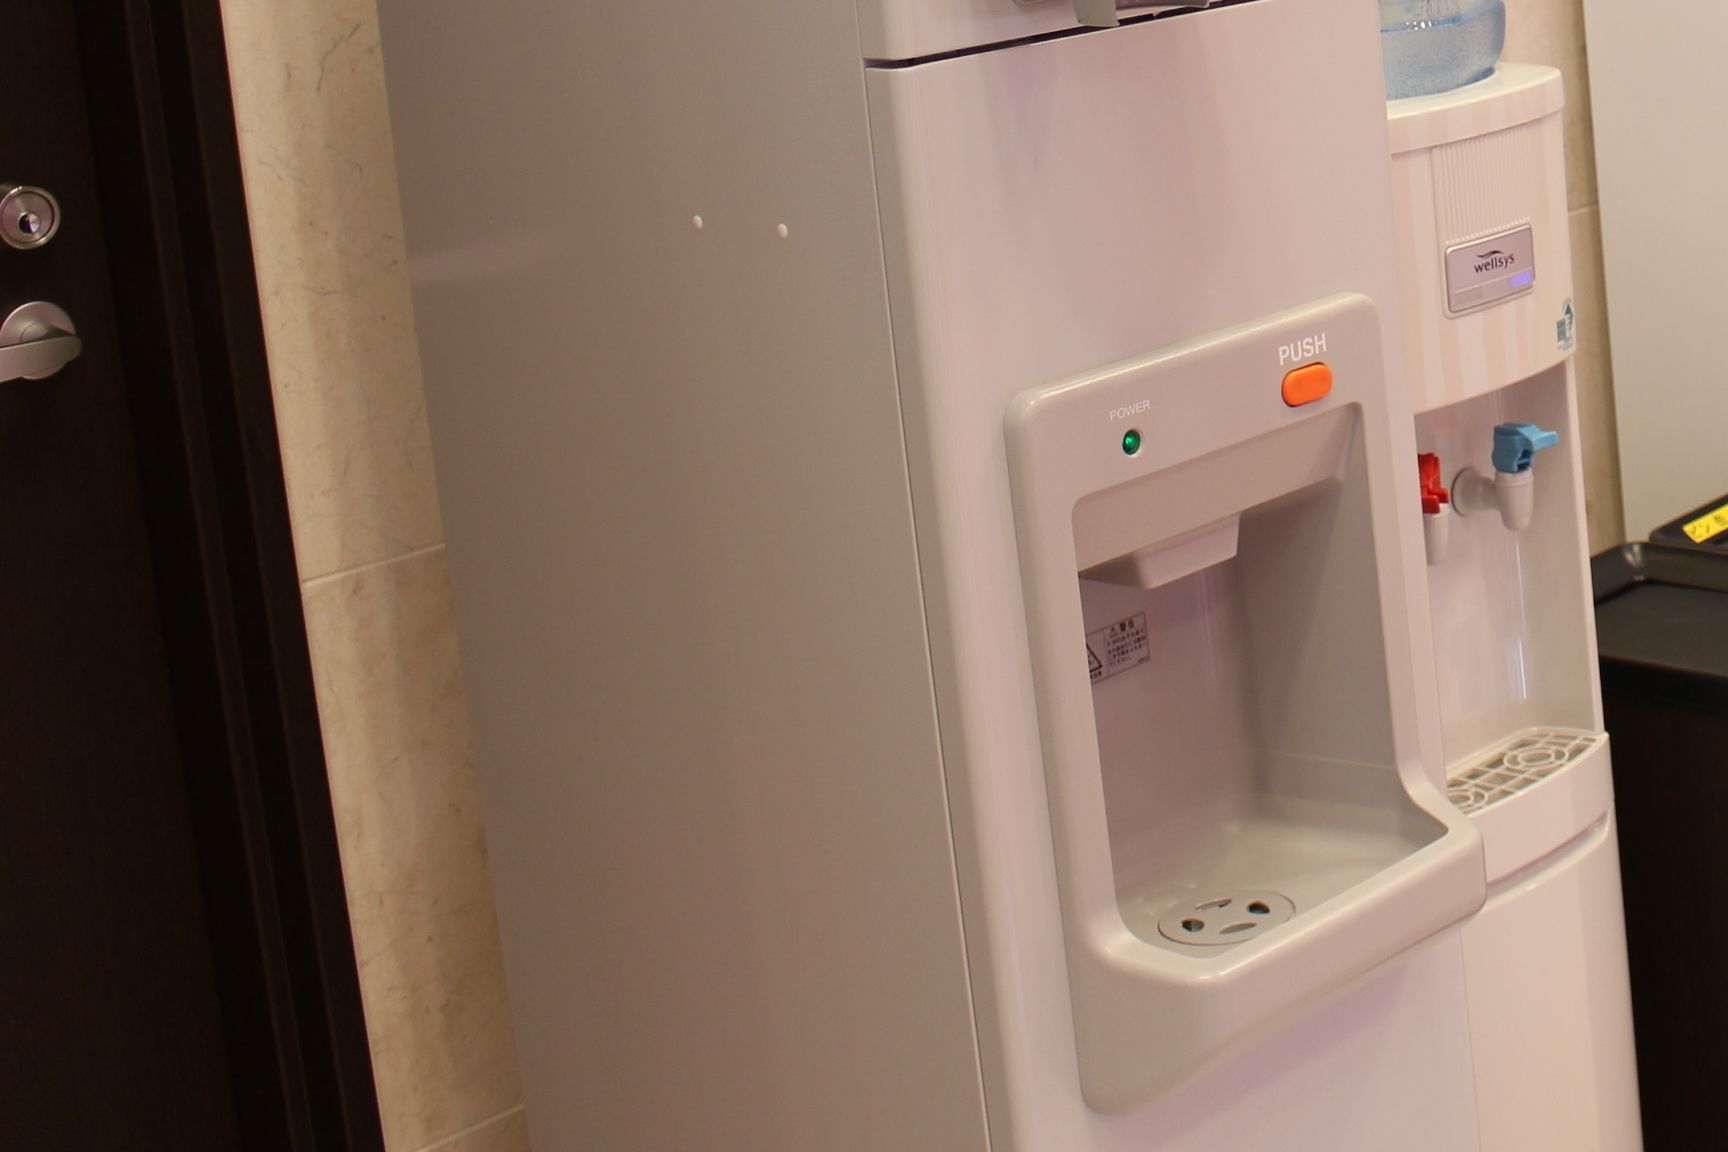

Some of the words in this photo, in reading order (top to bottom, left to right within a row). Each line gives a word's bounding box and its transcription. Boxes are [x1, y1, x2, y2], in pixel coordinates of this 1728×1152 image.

[1473, 253, 1515, 274] wellsys
[1278, 332, 1328, 366] PUSH
[1109, 399, 1151, 422] POWER
